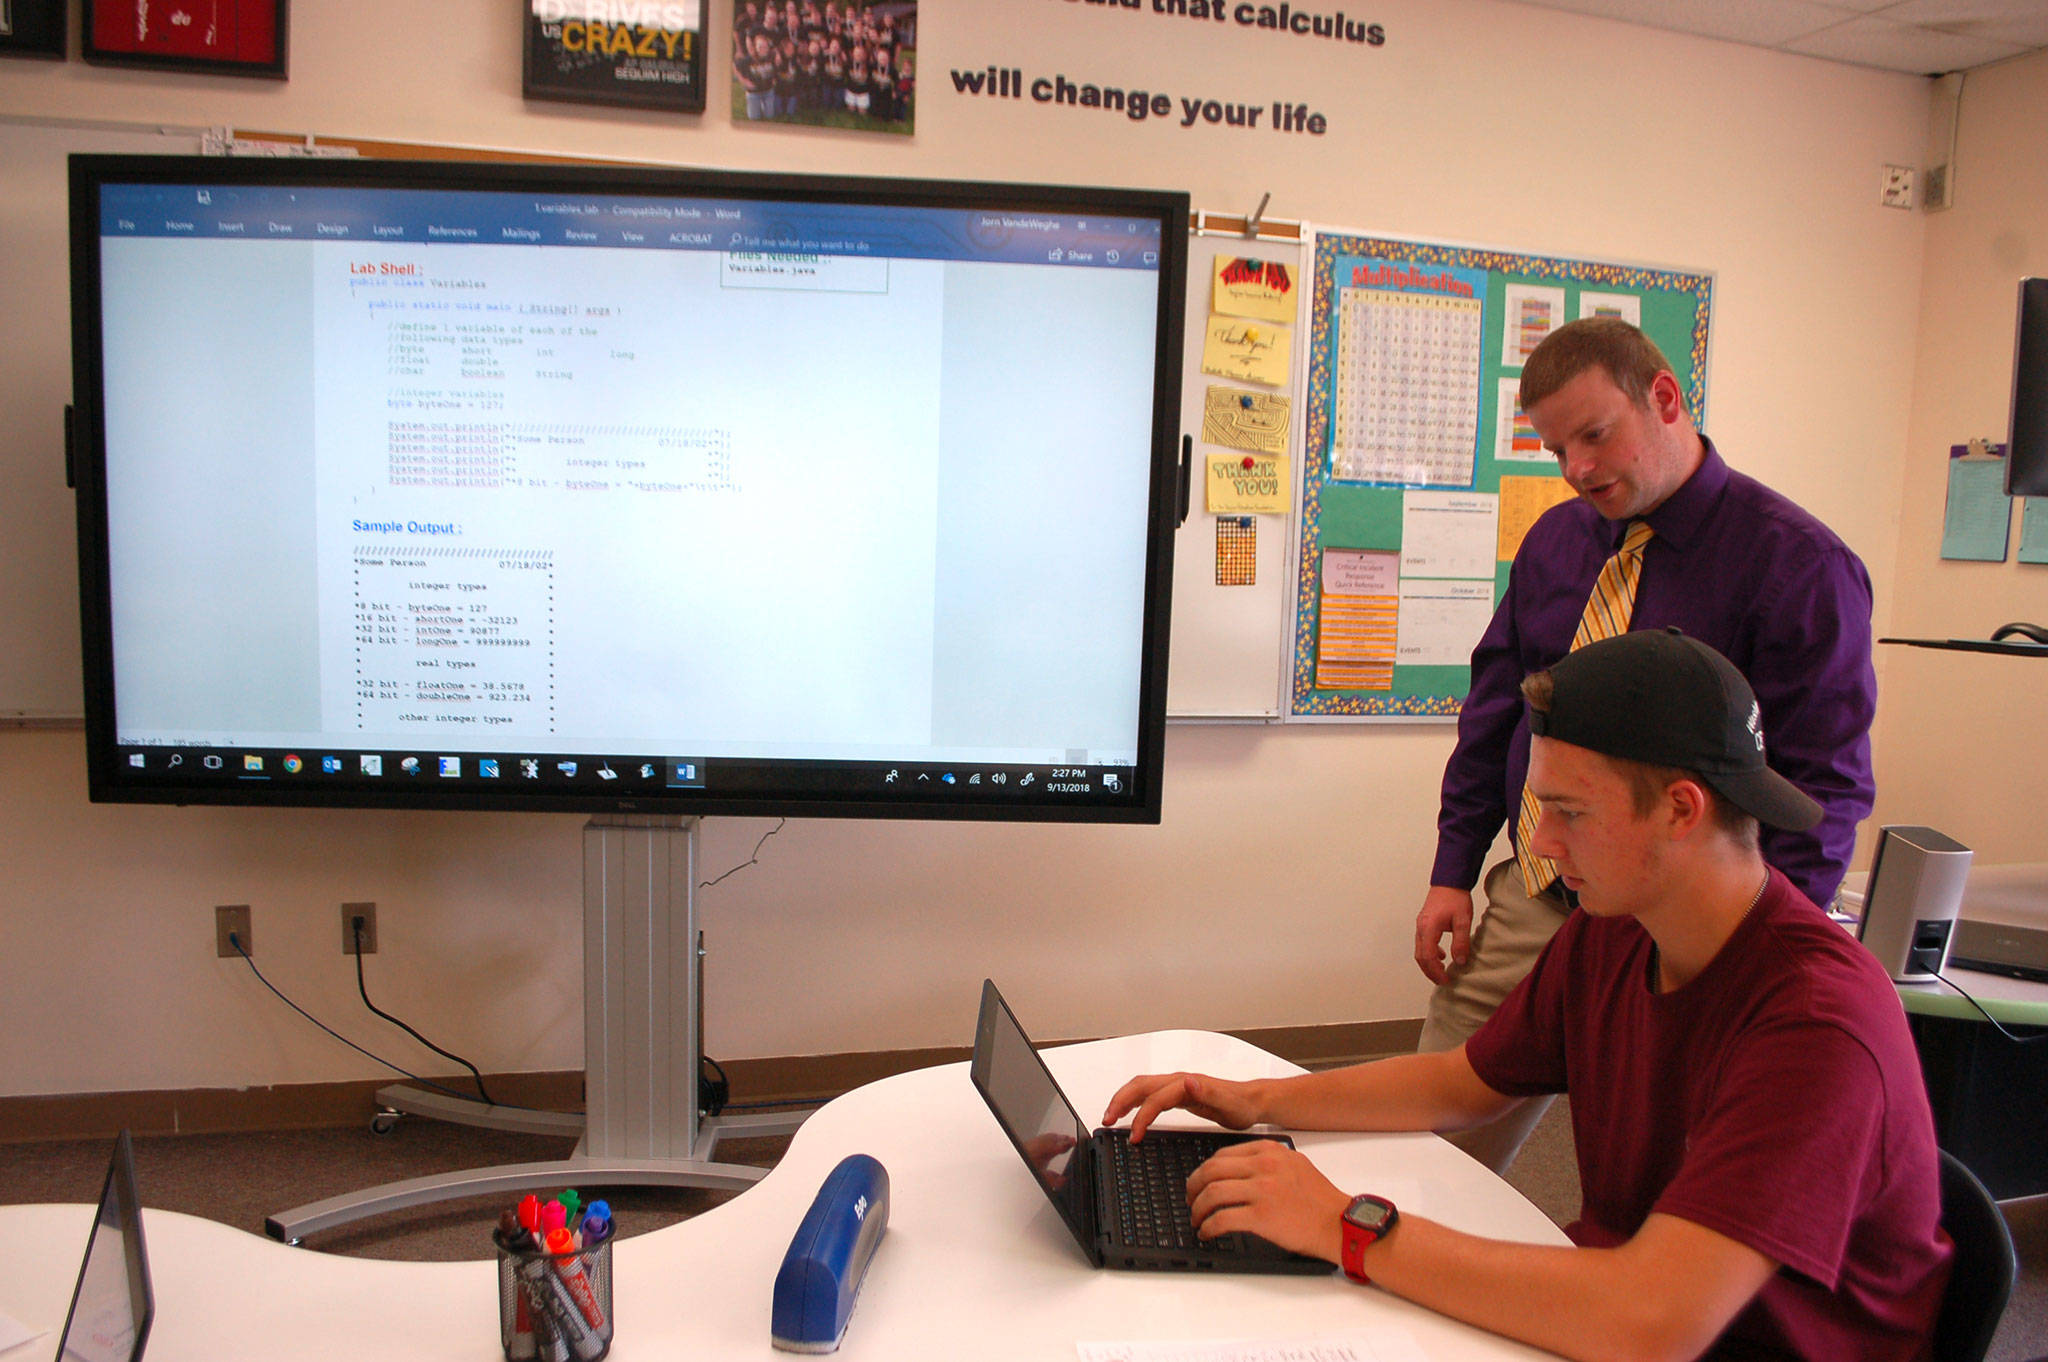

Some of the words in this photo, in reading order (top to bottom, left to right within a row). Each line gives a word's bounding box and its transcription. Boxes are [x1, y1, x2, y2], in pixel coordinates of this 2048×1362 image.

[1234, 3, 1386, 46] calculus
[561, 21, 692, 60] CRAZY!
[950, 66, 1022, 98] will
[1031, 75, 1171, 120] change
[1180, 96, 1263, 127] your
[1272, 102, 1327, 135] life
[613, 205, 672, 219] Compatibility
[675, 207, 701, 219] Mode
[715, 208, 741, 219] Word
[118, 219, 136, 231] File
[166, 221, 194, 232] Home
[218, 222, 245, 233] Insert
[268, 222, 292, 233] Draw
[317, 222, 349, 237] Design
[373, 224, 404, 237] Layout
[429, 225, 478, 238] References
[503, 227, 540, 241] Mailings
[565, 229, 597, 240] Review
[622, 231, 644, 242] View
[669, 232, 712, 243] ACROBAT
[778, 239, 799, 248] what
[801, 241, 818, 251] you
[821, 240, 841, 250] want
[1067, 250, 1093, 261] Share
[350, 262, 376, 275] Lab
[380, 263, 415, 275] Shell
[729, 263, 815, 276] Variables.java
[350, 278, 388, 288] public
[394, 279, 425, 287] class
[430, 280, 487, 289] Variables
[1352, 266, 1473, 296] Multiplication
[369, 301, 406, 311] public
[413, 302, 449, 310] static
[456, 325, 504, 334] variable
[462, 335, 486, 345] data
[493, 336, 523, 346] types
[450, 390, 505, 399] variables
[1213, 462, 1277, 478] THANK
[1233, 479, 1278, 496] YOU!
[352, 519, 403, 534] Sample
[407, 520, 454, 535] Output
[390, 558, 427, 568] Person
[409, 582, 450, 592] integer
[457, 582, 487, 592] types
[408, 603, 451, 613] byteOne
[470, 604, 488, 613] 127
[415, 637, 458, 647] longOne
[416, 659, 440, 667] real
[446, 660, 476, 669] types
[416, 681, 464, 690] floatOne
[416, 692, 471, 701] doubleOne
[488, 693, 531, 702] 923.234
[399, 713, 428, 722] other
[436, 714, 478, 724] integer
[484, 715, 513, 725] types
[1052, 769, 1070, 778] 2:27
[1072, 769, 1086, 778] PM
[1047, 783, 1090, 792] 9/13/2018
